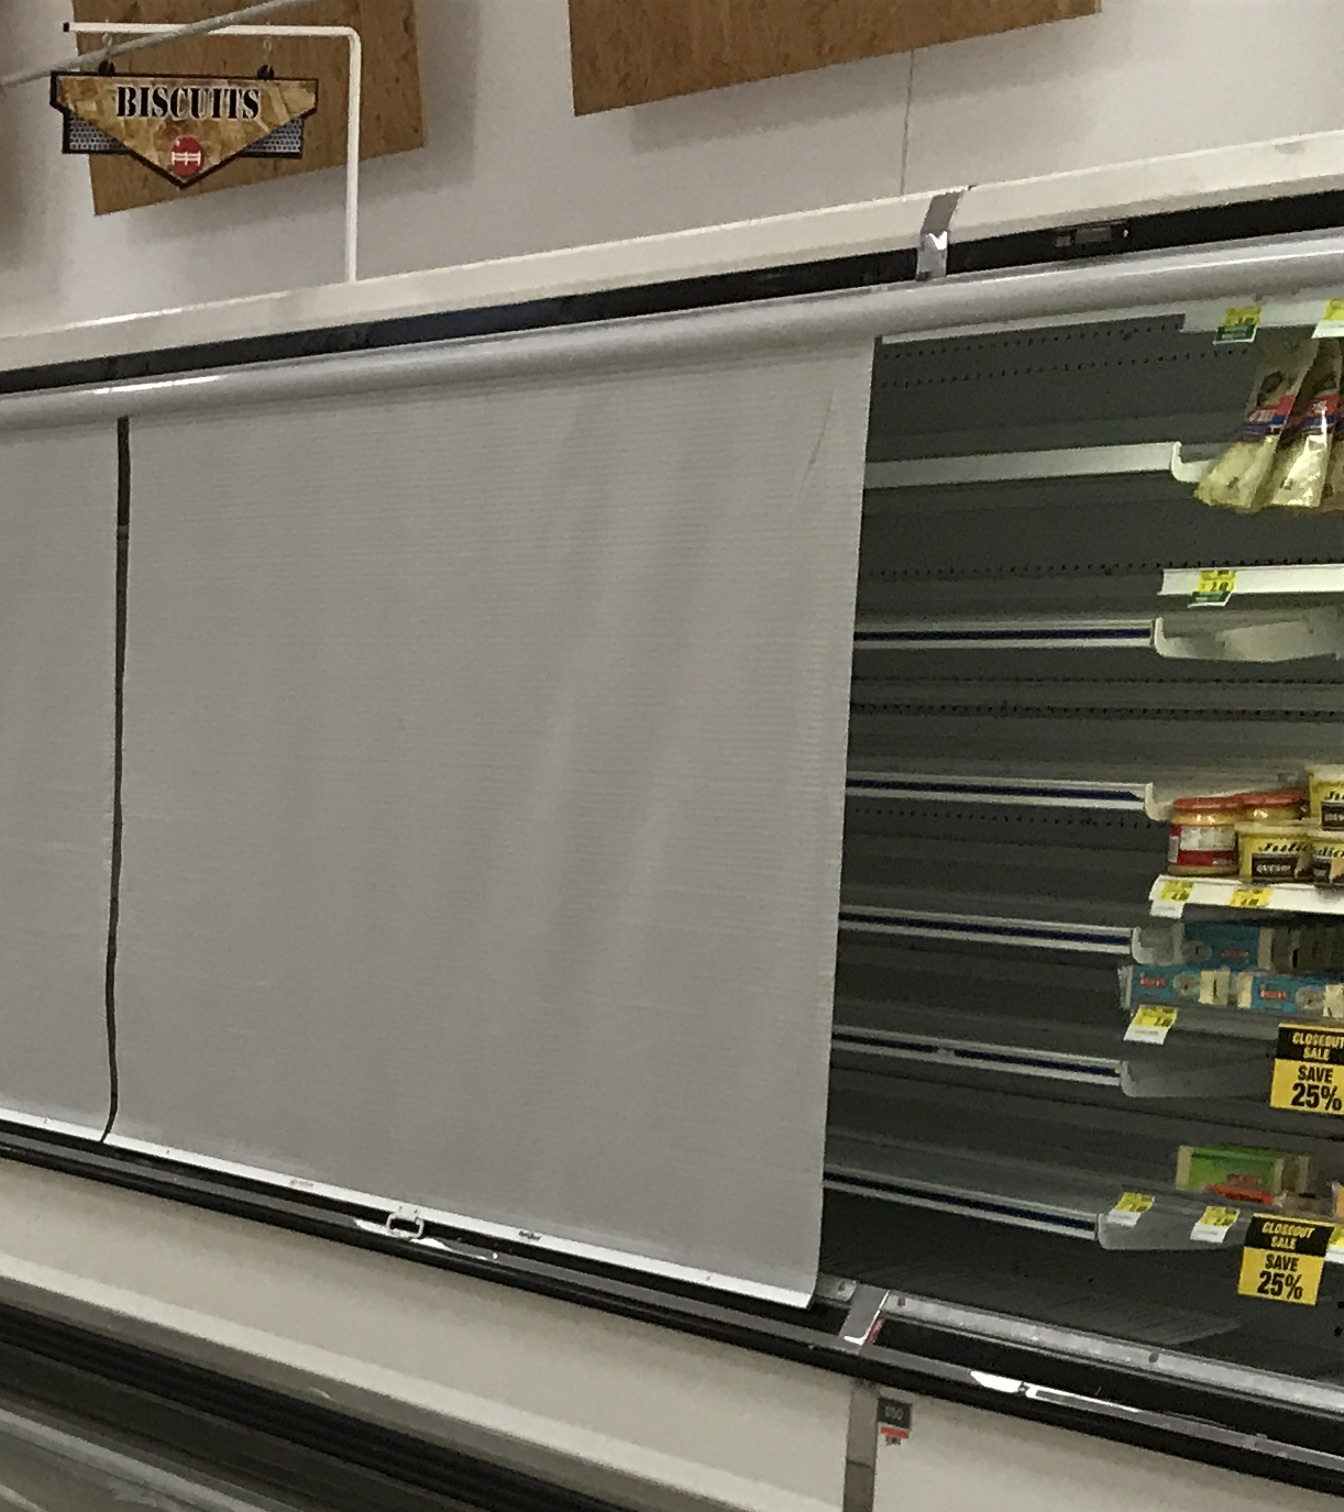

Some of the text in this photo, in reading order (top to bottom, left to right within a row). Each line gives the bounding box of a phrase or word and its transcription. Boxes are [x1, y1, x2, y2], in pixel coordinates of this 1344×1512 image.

[116, 85, 260, 119] BISCUITS
[1303, 1046, 1331, 1061] SALE
[1298, 1065, 1334, 1084] SAVE
[1291, 1082, 1342, 1111] 25%
[1261, 1221, 1316, 1239] CLOSEOUT
[1270, 1235, 1298, 1250] SALE
[1265, 1253, 1299, 1272] SAVE
[1257, 1270, 1304, 1300] 25%
